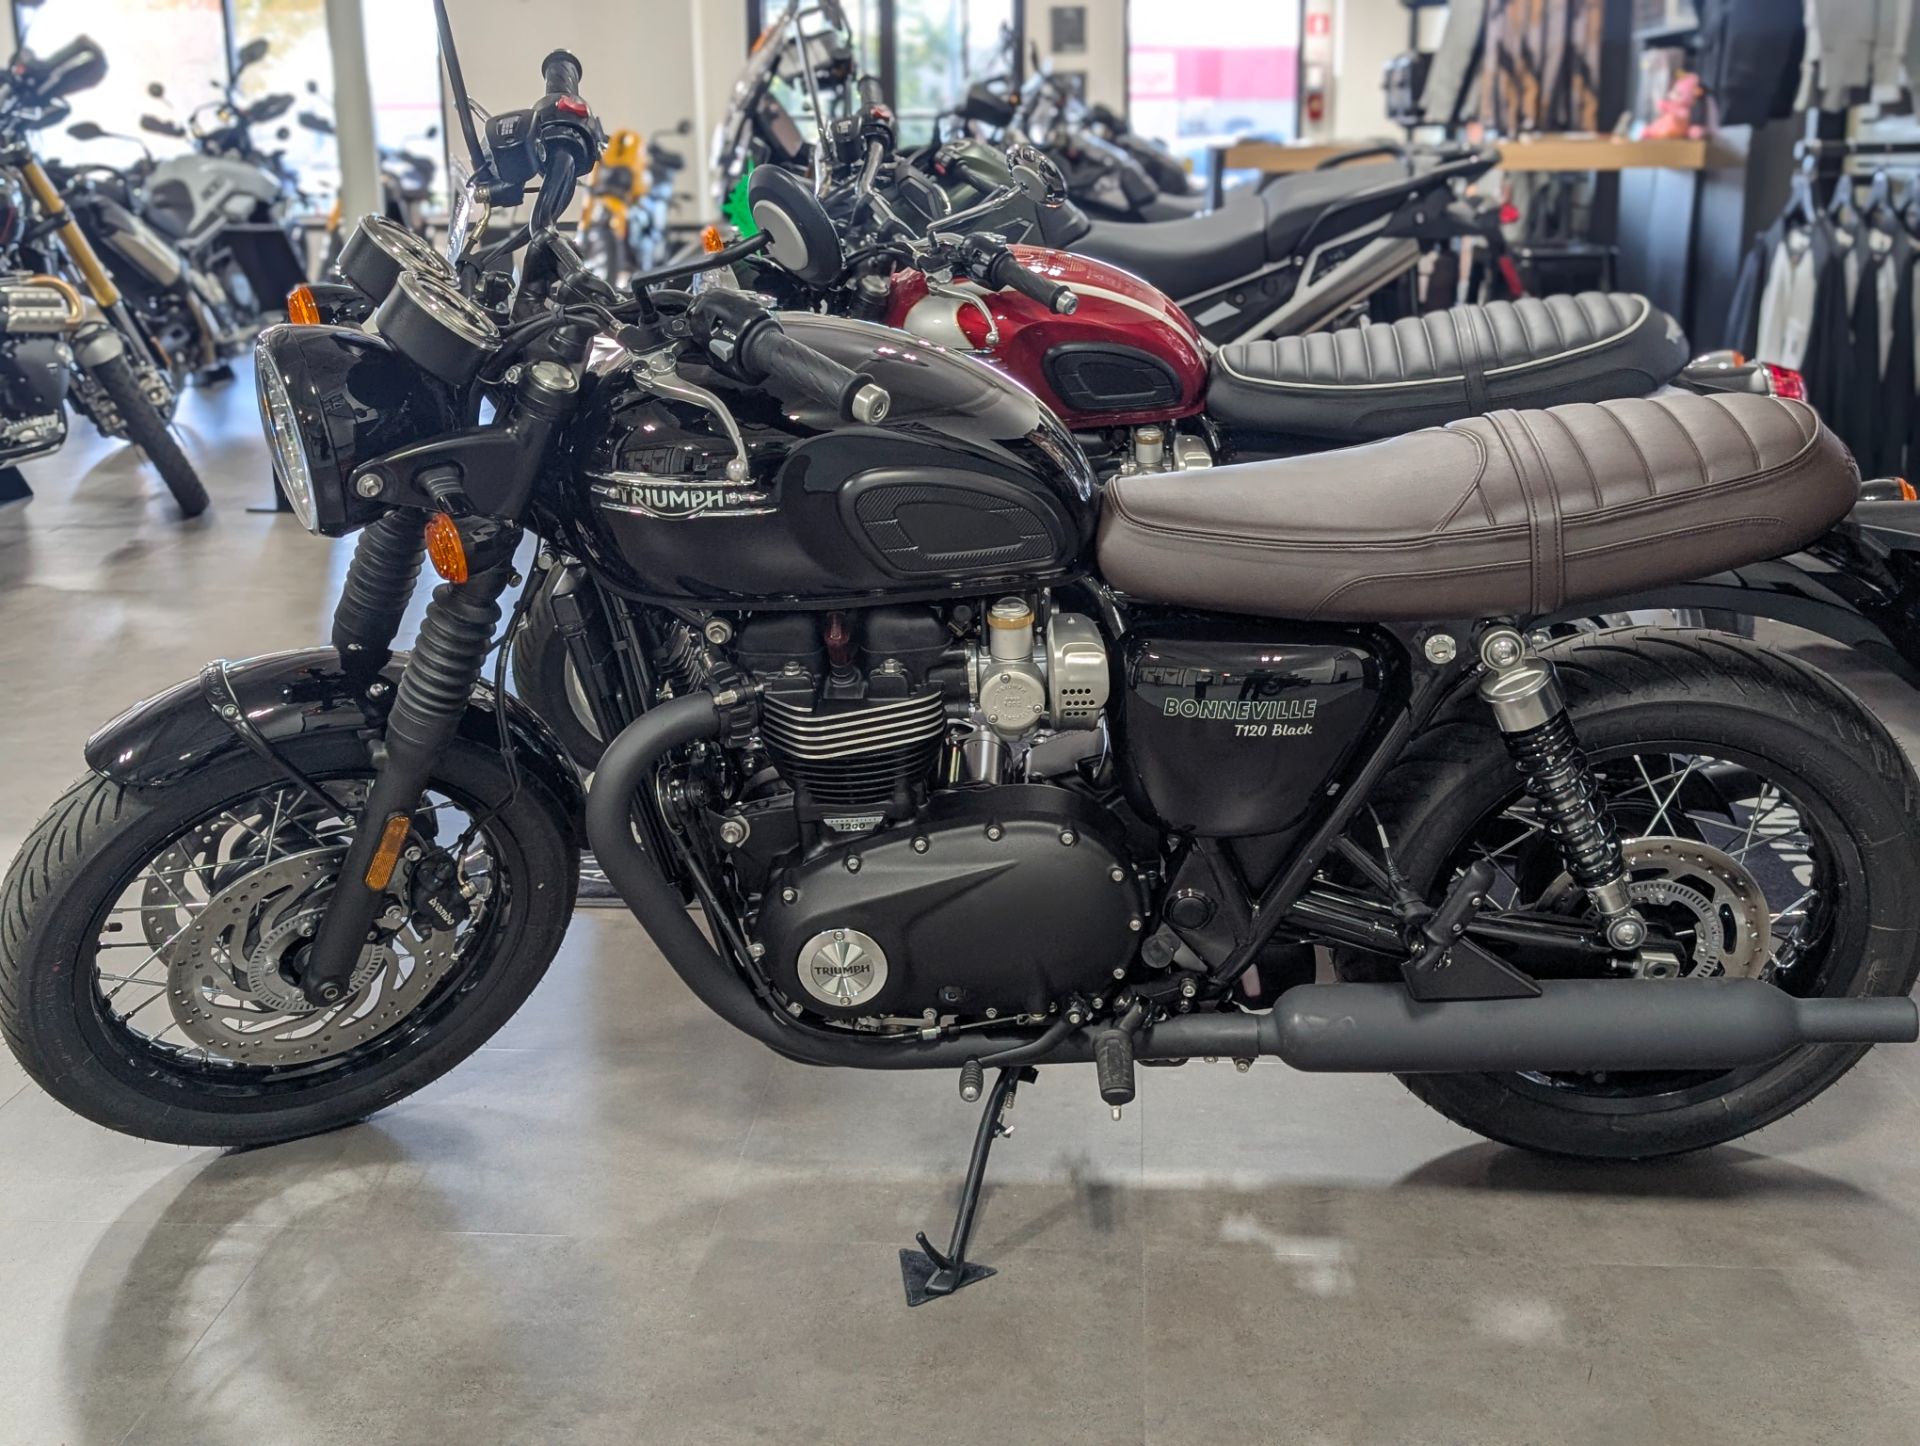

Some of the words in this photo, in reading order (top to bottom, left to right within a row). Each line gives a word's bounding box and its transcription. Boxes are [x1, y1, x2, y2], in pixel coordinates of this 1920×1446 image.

[617, 485, 725, 512] TRIUMPH
[1163, 697, 1317, 720] BONNEVILLE
[1235, 724, 1267, 737] T120
[1271, 723, 1313, 737] Black
[840, 823, 866, 831] 1200
[428, 896, 455, 925] brembo
[814, 964, 871, 977] TRIUMPH
